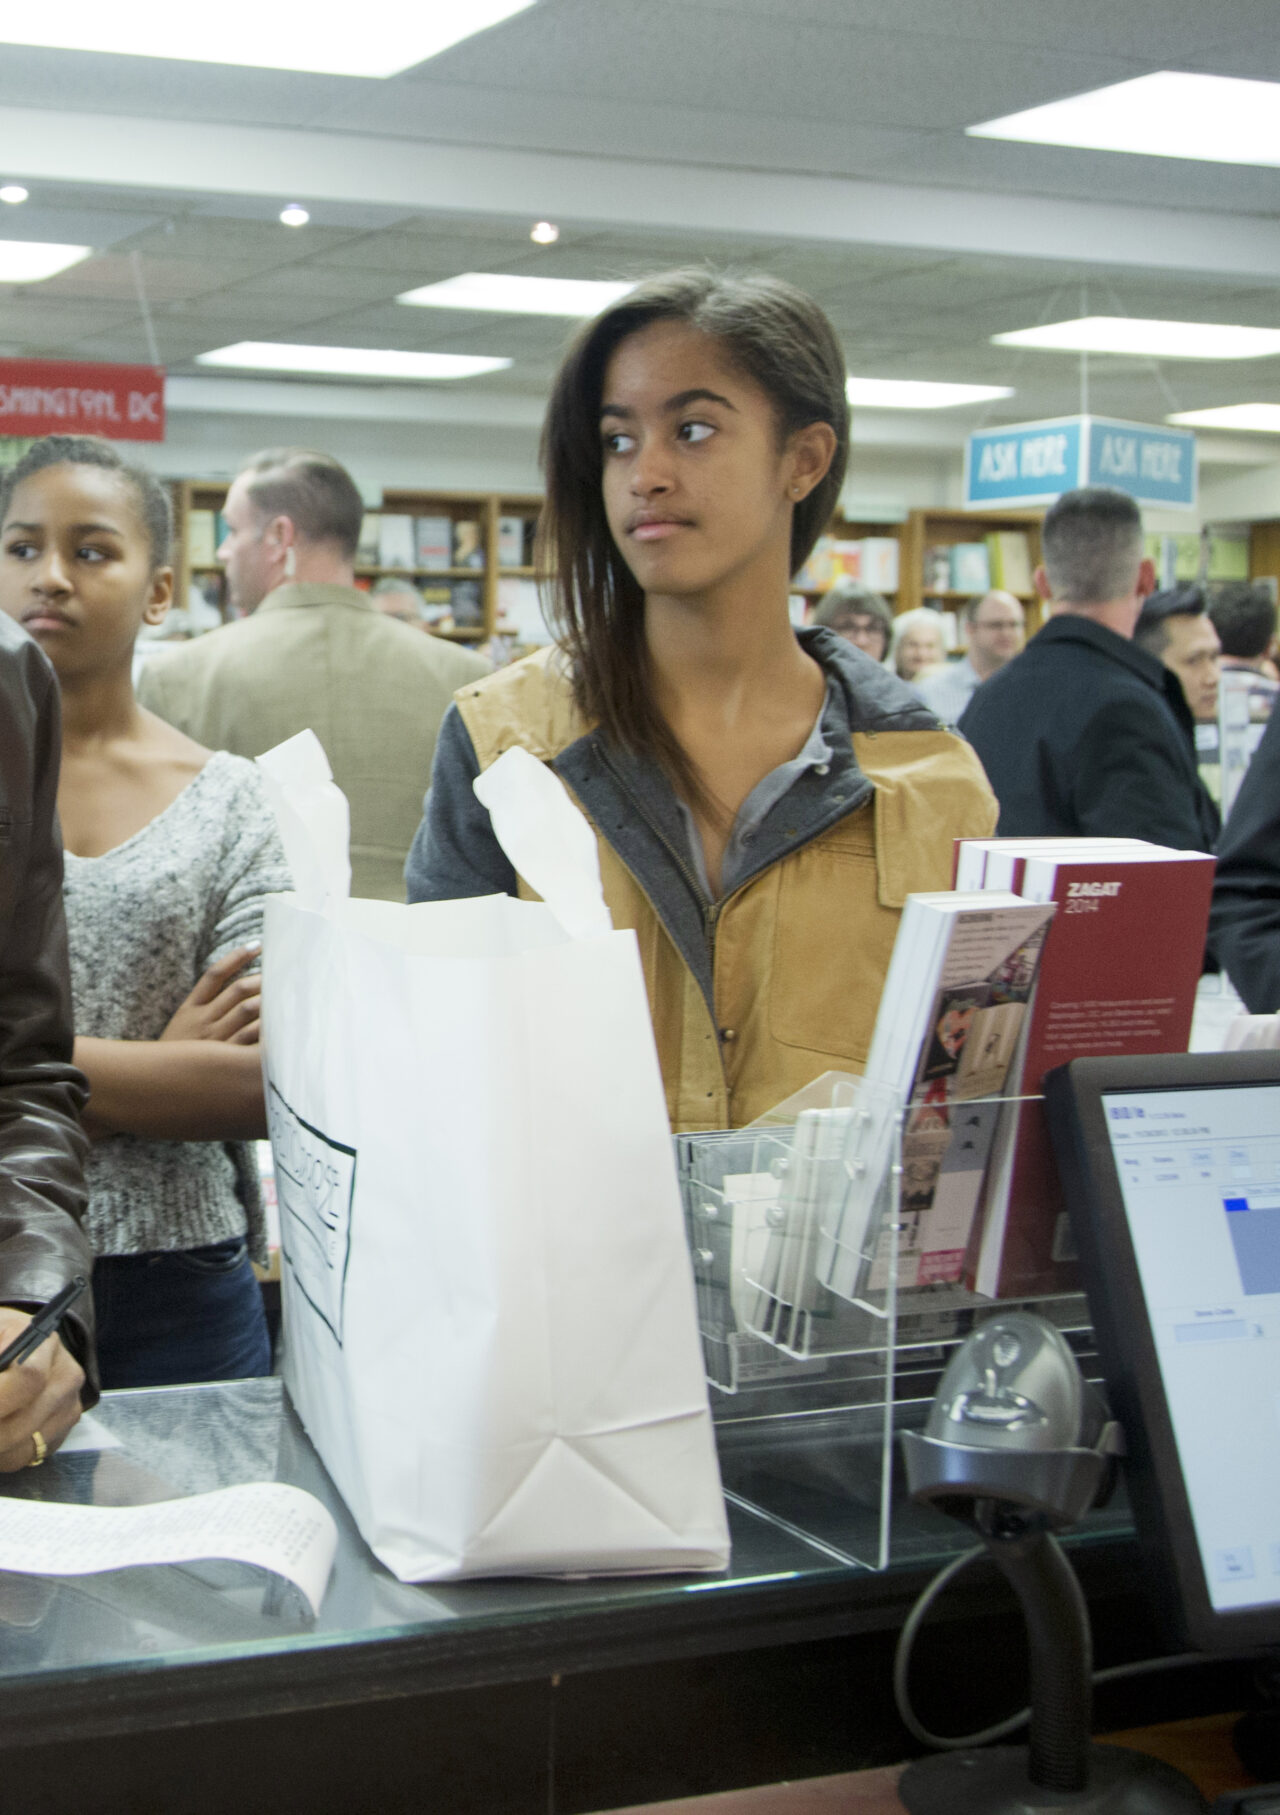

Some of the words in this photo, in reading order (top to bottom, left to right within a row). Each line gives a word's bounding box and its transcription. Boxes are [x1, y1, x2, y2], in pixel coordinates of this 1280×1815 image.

[128, 390, 160, 422] DC
[978, 440, 1019, 484] ASK
[1020, 433, 1068, 479] HERE
[1099, 433, 1139, 477] ASK
[1140, 439, 1182, 485] HERE
[1066, 881, 1122, 897] ZAGAT
[1064, 898, 1100, 914] 2014
